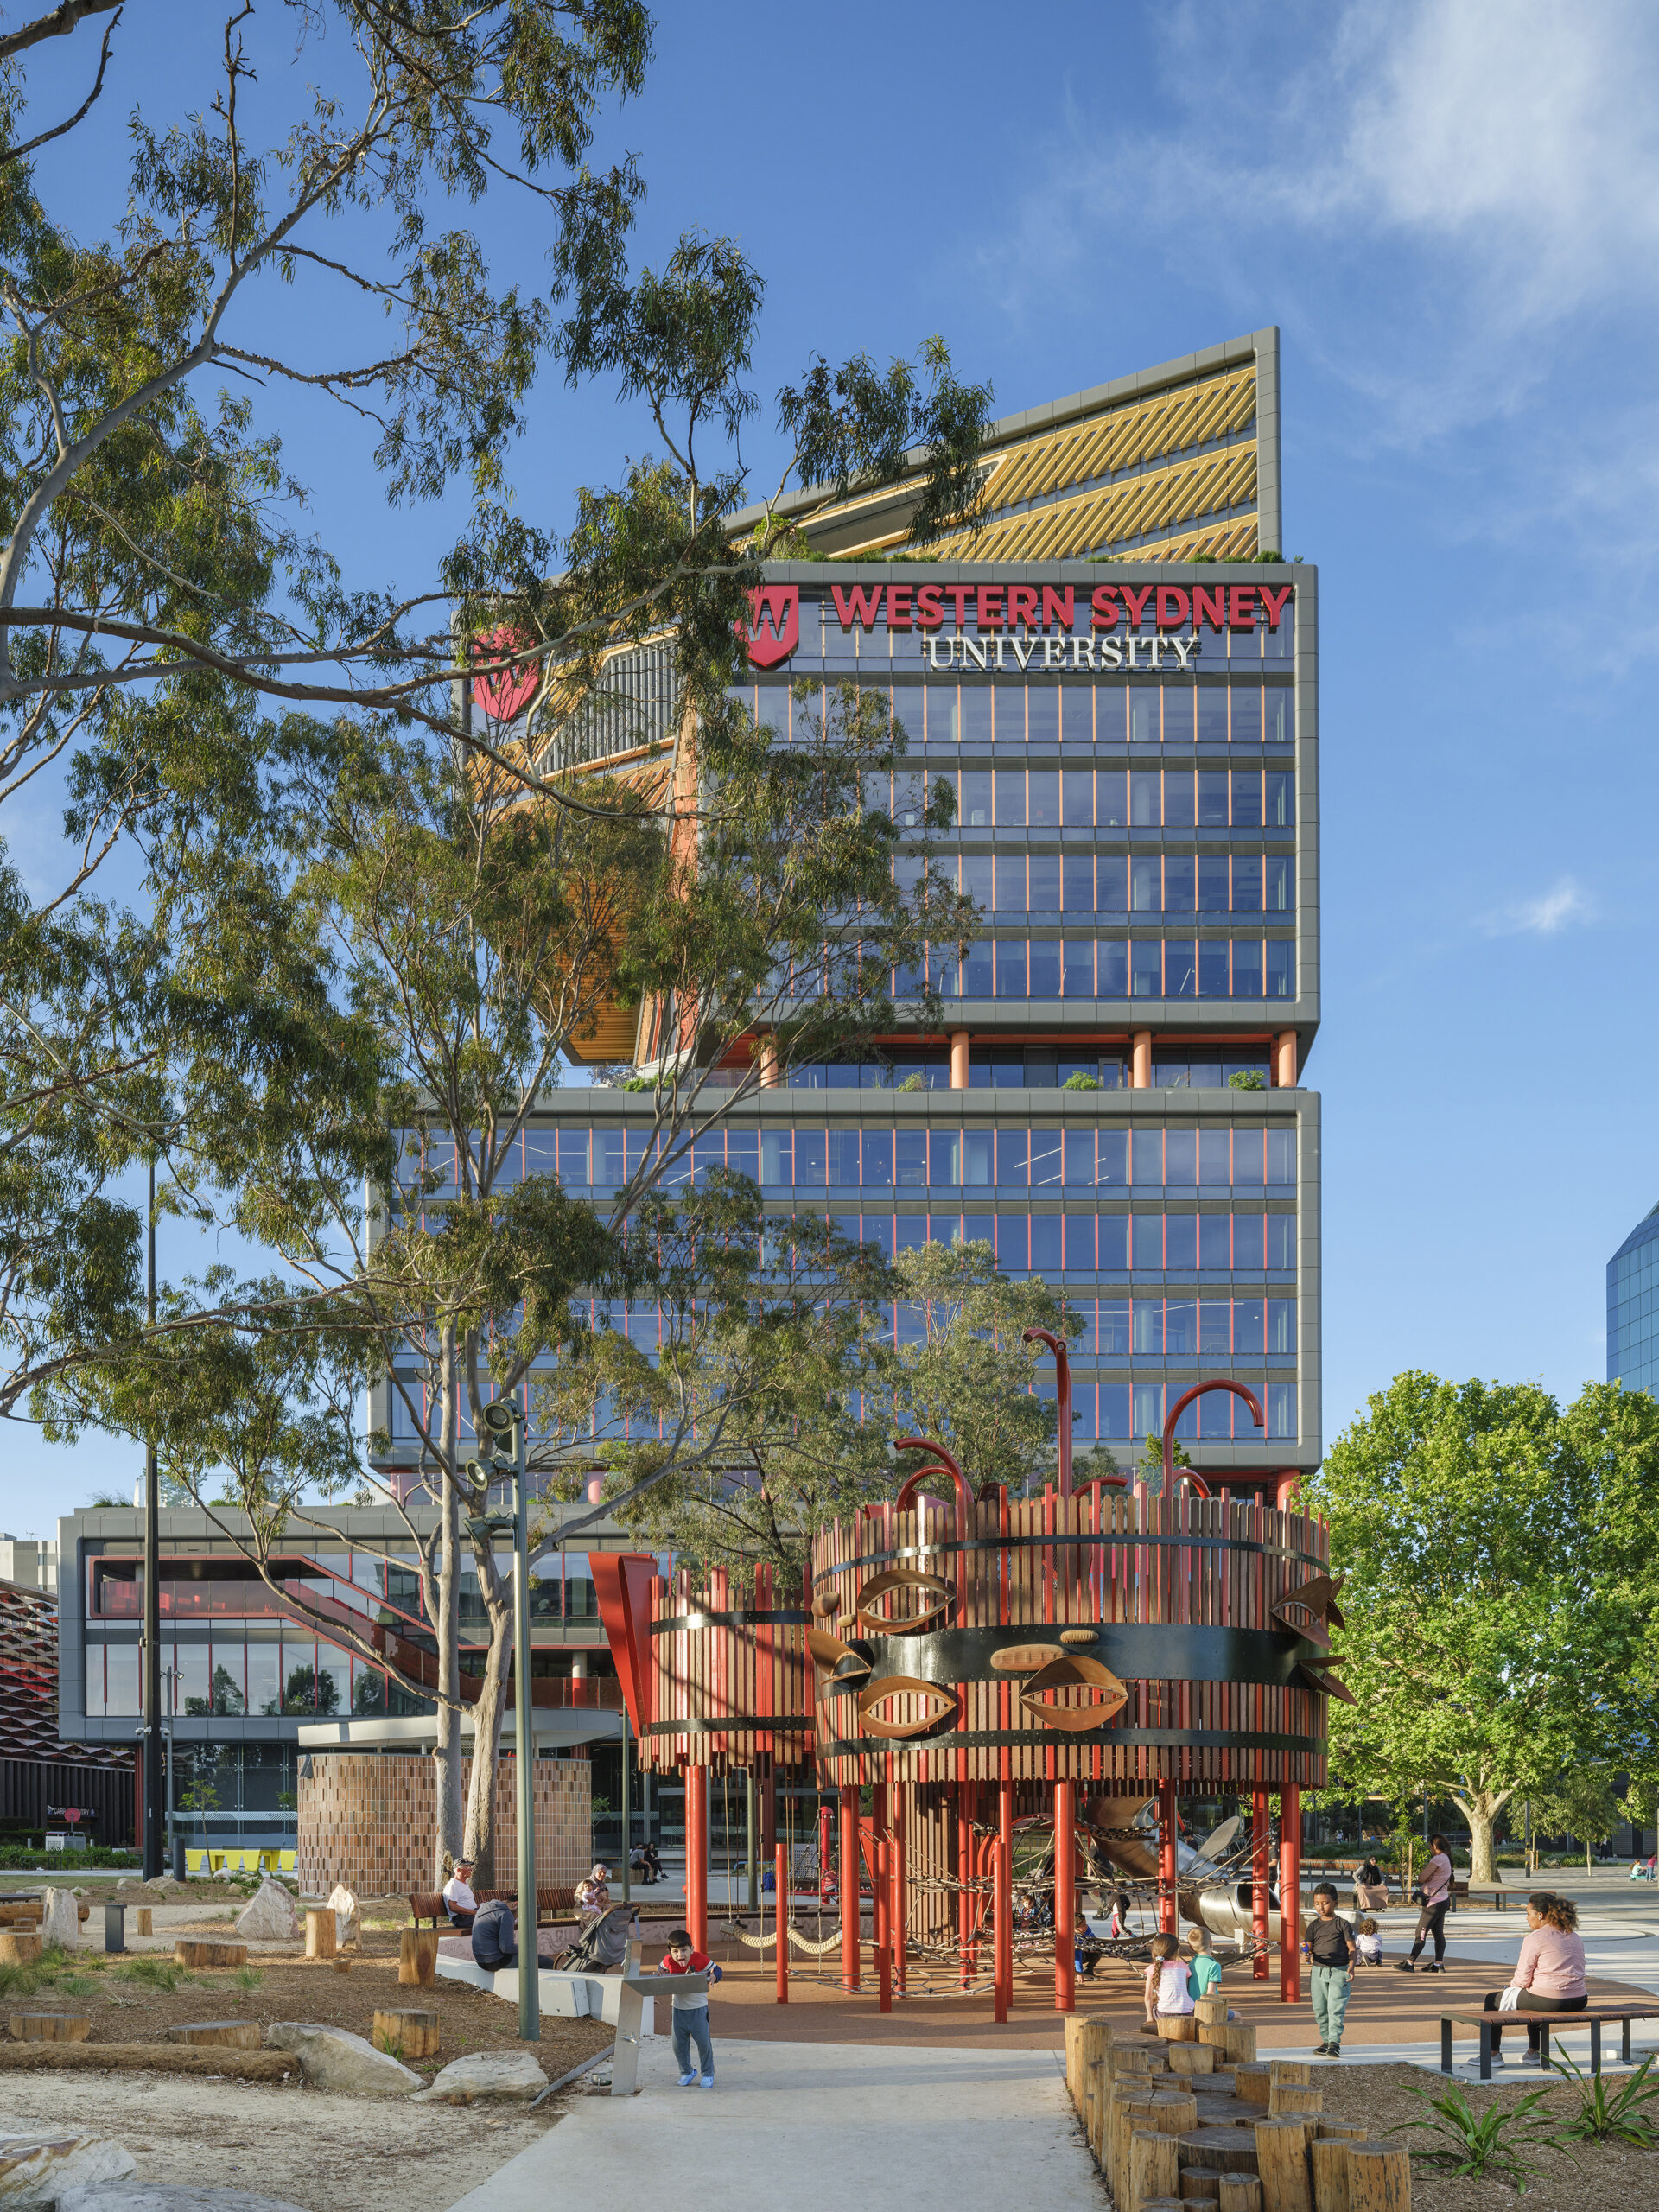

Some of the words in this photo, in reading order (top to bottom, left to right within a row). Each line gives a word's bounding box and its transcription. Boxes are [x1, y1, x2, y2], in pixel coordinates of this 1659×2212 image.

[831, 584, 1074, 628] WESTERN
[1091, 585, 1293, 628] SYDNEY
[926, 636, 1198, 671] UNIVERSITY
